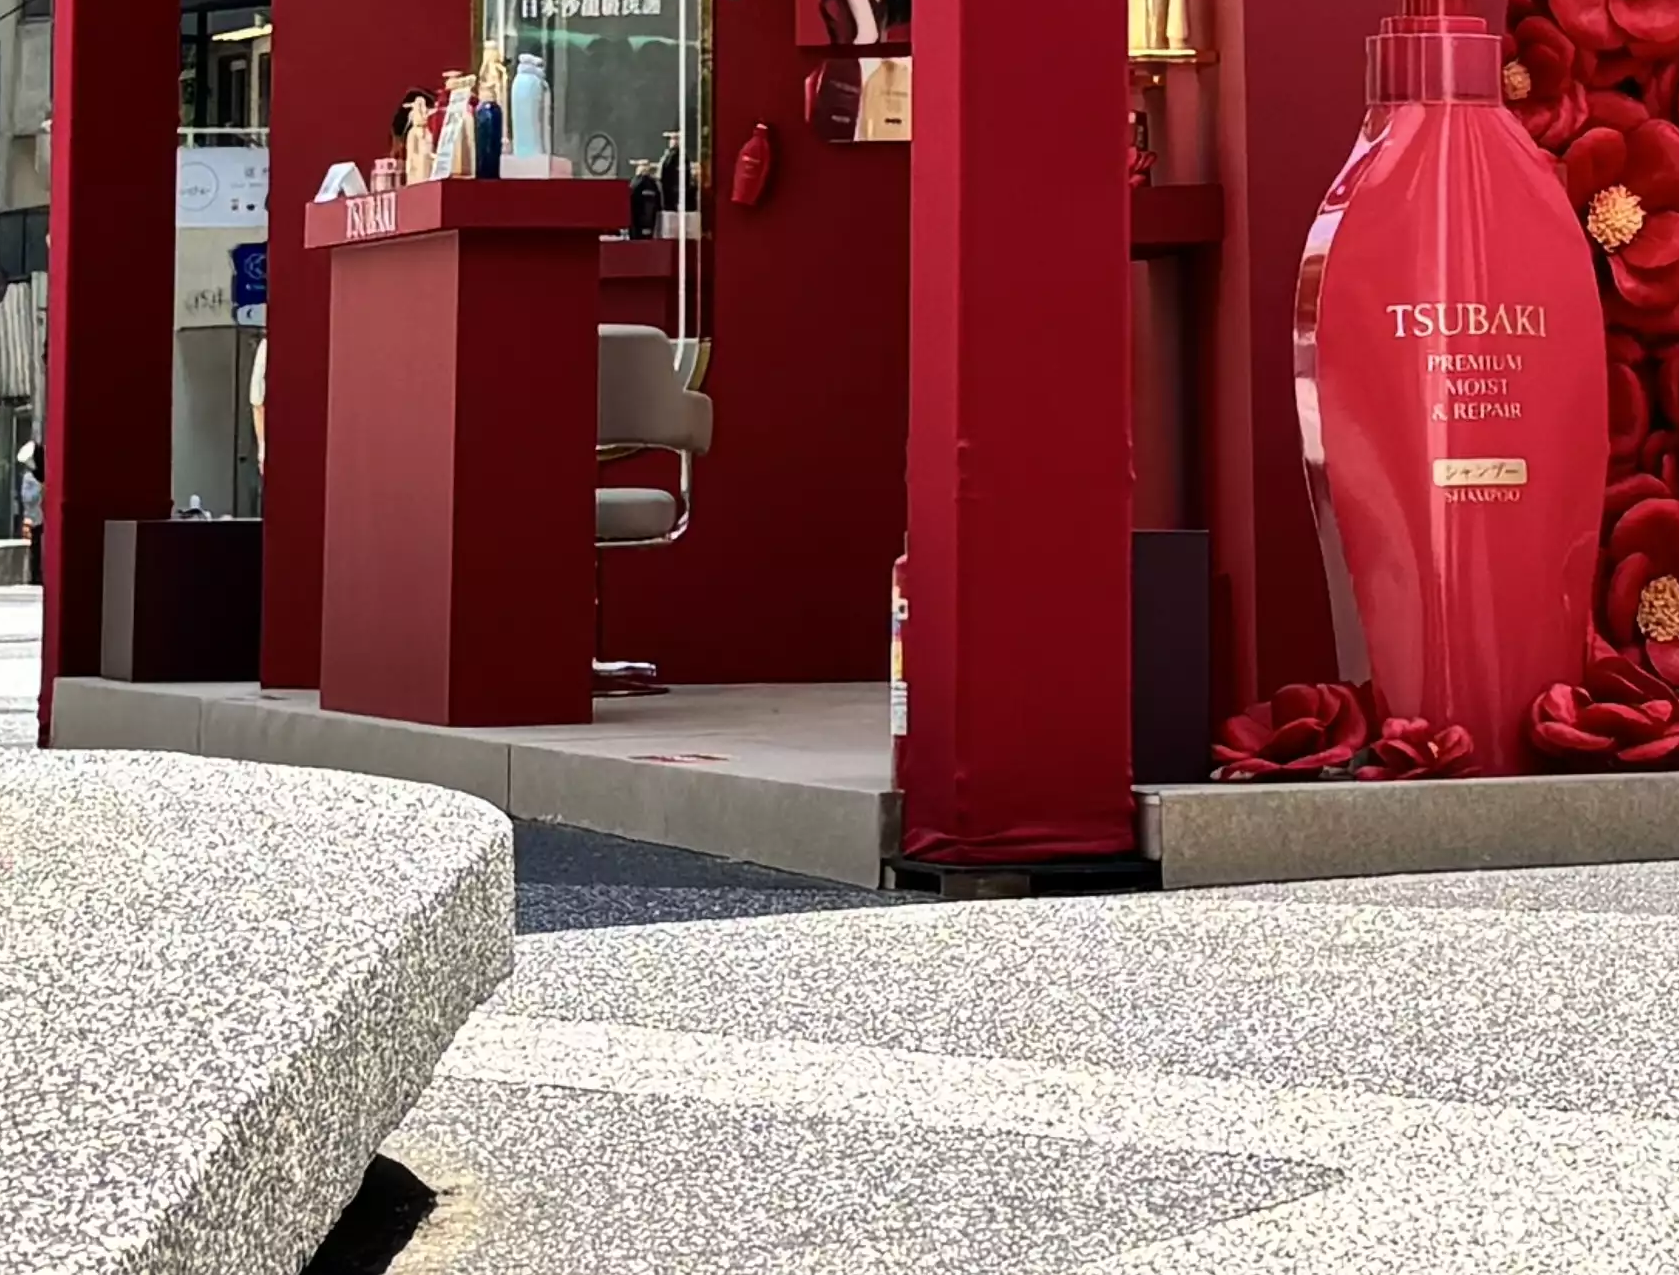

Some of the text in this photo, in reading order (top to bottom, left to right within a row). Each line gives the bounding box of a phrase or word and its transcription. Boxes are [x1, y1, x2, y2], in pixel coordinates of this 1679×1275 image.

[1386, 302, 1547, 338] TSUBAKI
[1427, 354, 1522, 373] PREMIUM
[1445, 378, 1508, 396] MOIST
[1432, 402, 1522, 422] & REPAIR
